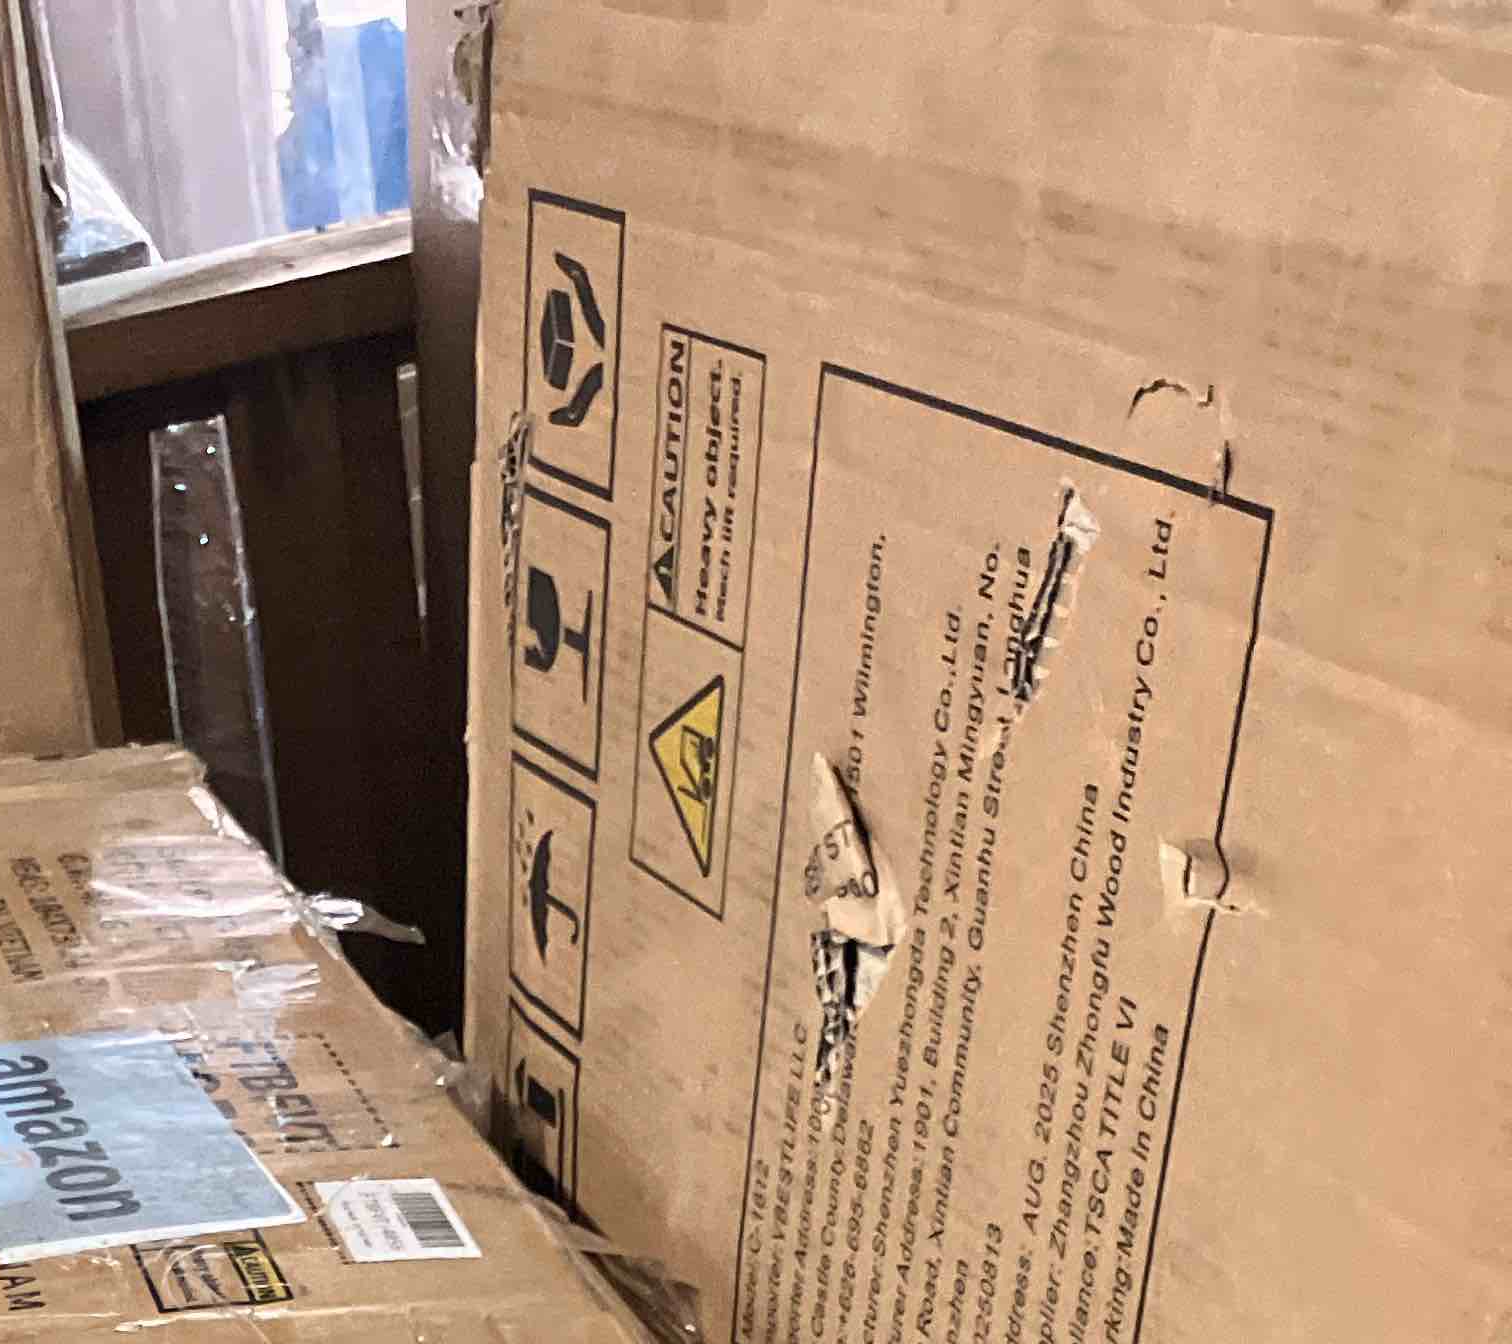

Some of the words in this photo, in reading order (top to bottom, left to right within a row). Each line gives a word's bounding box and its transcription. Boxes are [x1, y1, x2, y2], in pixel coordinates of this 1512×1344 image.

[659, 339, 684, 542] CAUTION
[694, 496, 717, 616] Heavy
[922, 944, 955, 1068] Building
[943, 791, 968, 902] Xintian
[978, 543, 999, 600] No.
[1111, 675, 1152, 822] Industry
[913, 740, 948, 915] Technology
[1097, 828, 1126, 926] Wood
[927, 1145, 954, 1247] Xintian
[967, 827, 995, 951] Guanhu
[1034, 1063, 1058, 1144] 2025
[1046, 892, 1083, 1056] Shenzhen
[1070, 783, 1098, 882] China
[1075, 937, 1110, 1076] Zhongfu
[790, 1023, 807, 1080] LLC
[1099, 1039, 1129, 1138] TITLE
[1115, 996, 1136, 1028] VI
[1137, 1023, 1168, 1121] China
[1048, 1081, 1088, 1260] Zhangzhou
